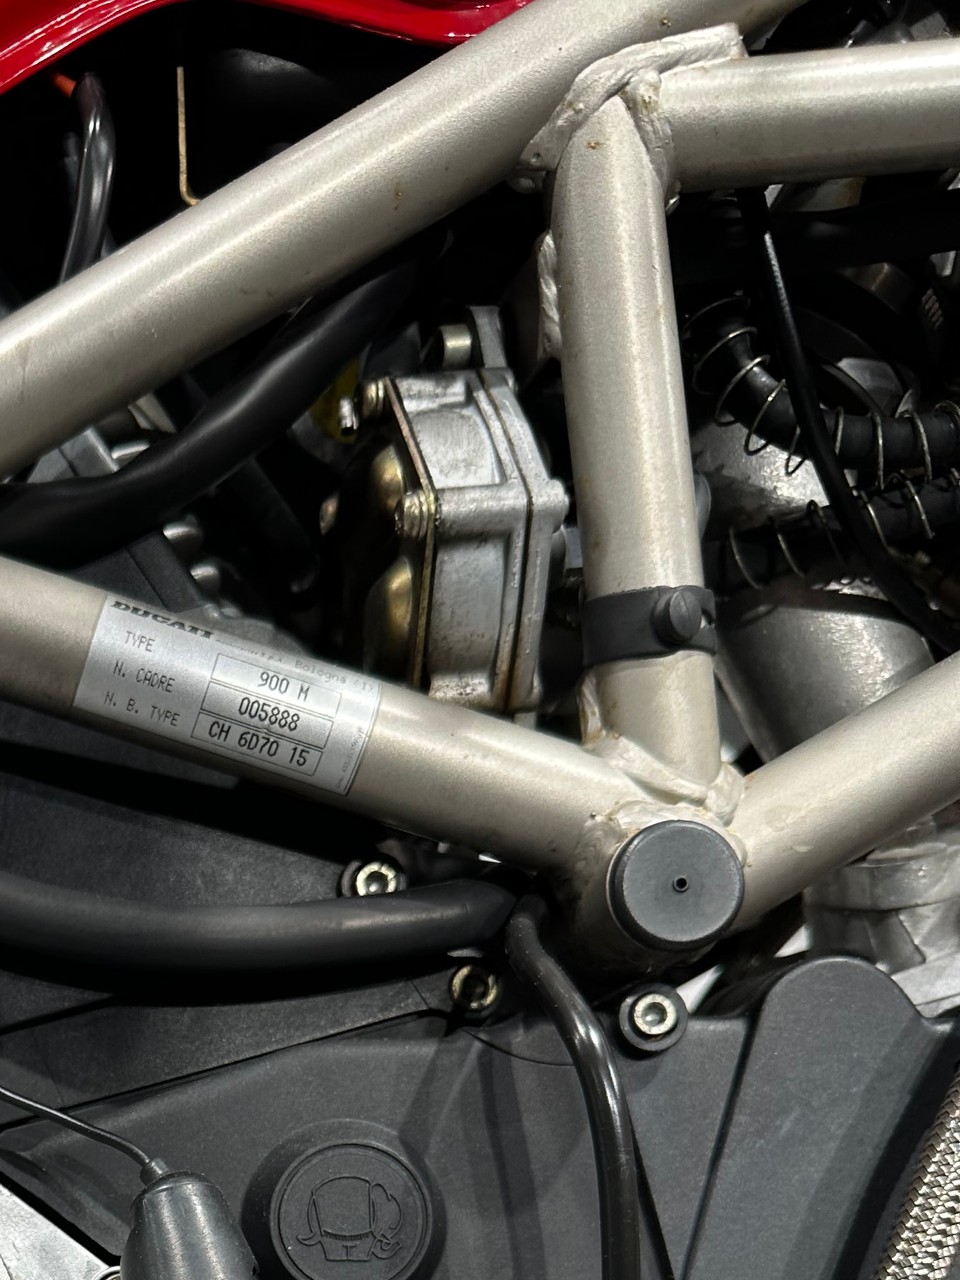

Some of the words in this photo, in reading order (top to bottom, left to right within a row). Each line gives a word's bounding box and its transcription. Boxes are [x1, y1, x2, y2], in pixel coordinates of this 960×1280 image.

[110, 600, 215, 640] DUCATI
[294, 659, 347, 684] Bologna
[125, 630, 156, 653] TYPE
[257, 671, 290, 695] 900
[297, 683, 311, 702] M
[104, 690, 117, 707] N.
[126, 698, 139, 714] B.
[150, 705, 181, 727] TYPE
[208, 720, 232, 742] CH
[289, 746, 311, 767] 15
[113, 660, 126, 678] N.
[136, 667, 176, 693] CADRE
[238, 696, 301, 732] 005888
